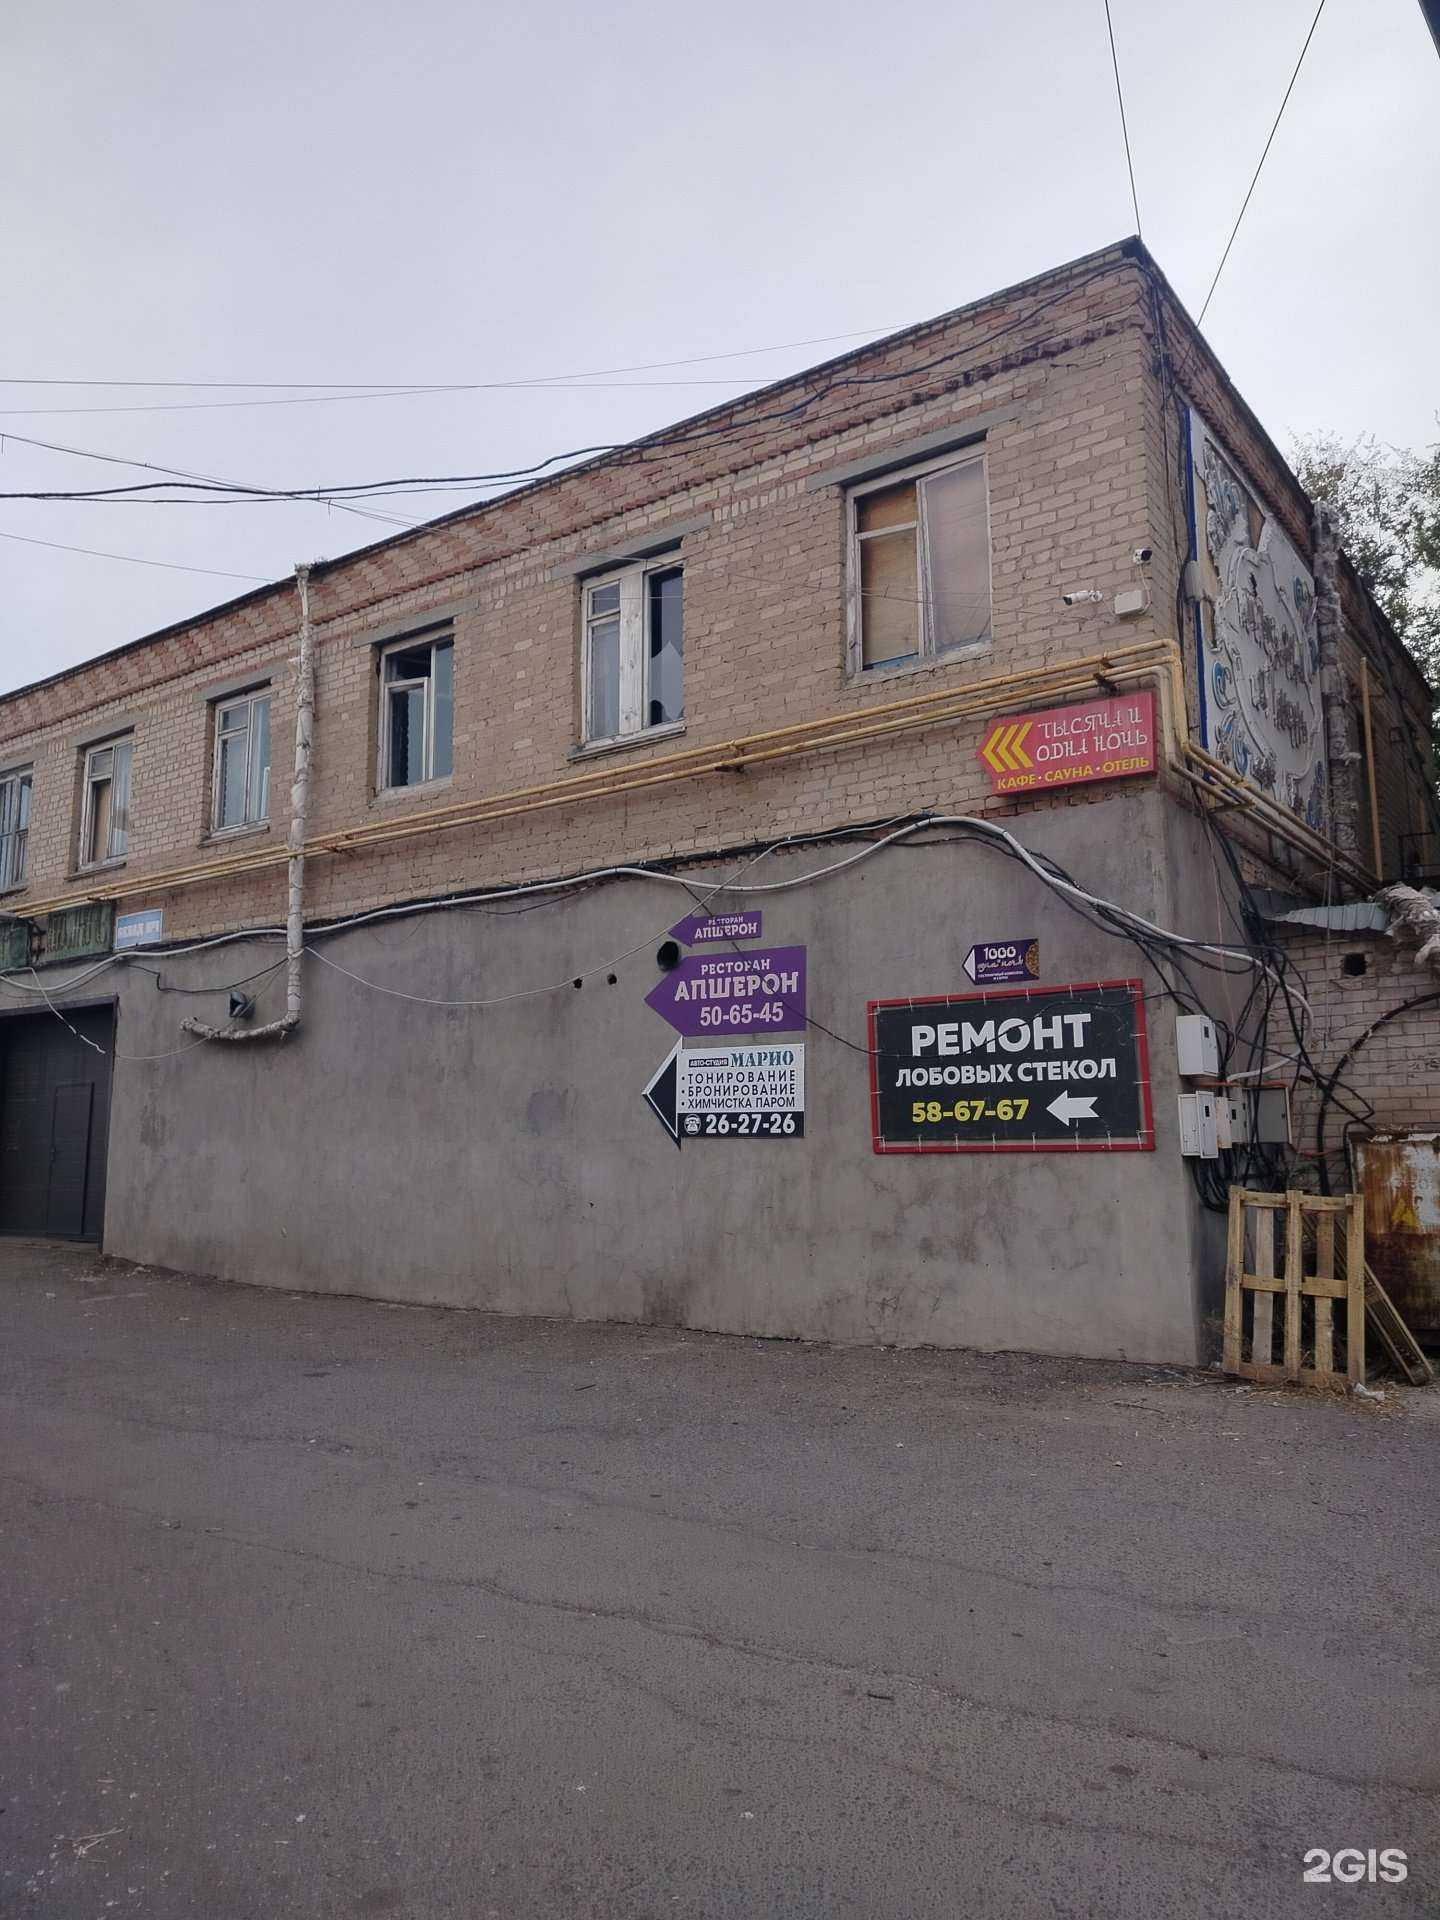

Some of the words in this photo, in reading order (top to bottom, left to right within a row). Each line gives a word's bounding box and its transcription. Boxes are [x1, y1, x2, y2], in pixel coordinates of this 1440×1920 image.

[1038, 710, 1121, 738] ТЫСЯЧА
[1128, 707, 1143, 724] И
[1036, 741, 1089, 762] ОДНА
[1093, 729, 1148, 752] НОЧЬ
[996, 774, 1037, 790] КАФЕ
[1044, 764, 1094, 782] САУНА
[1102, 756, 1150, 773] ОТЕЛЬ
[694, 922, 758, 939] АПШЕРОН
[984, 946, 1016, 960] 1000
[701, 958, 771, 976] РЕСТОРАН
[674, 971, 799, 1001] АПШЕРОН
[700, 1001, 784, 1026] 50-65-45
[911, 1013, 1092, 1057] РЕМОНТ
[730, 1050, 794, 1068] МАРИО
[688, 1069, 796, 1084] ТОНИРОВАНИЕ
[895, 1063, 1014, 1087] ЛОБОВЫХ
[1017, 1058, 1117, 1083] СТЕКОЛ
[688, 1083, 795, 1097] БРОНИРОВАНИЕ
[688, 1097, 752, 1109] ХИМЧИСТКА
[755, 1096, 795, 1108] ПАРОМ
[911, 1099, 1029, 1123] 58-67-67
[705, 1113, 796, 1134] 26-27-26
